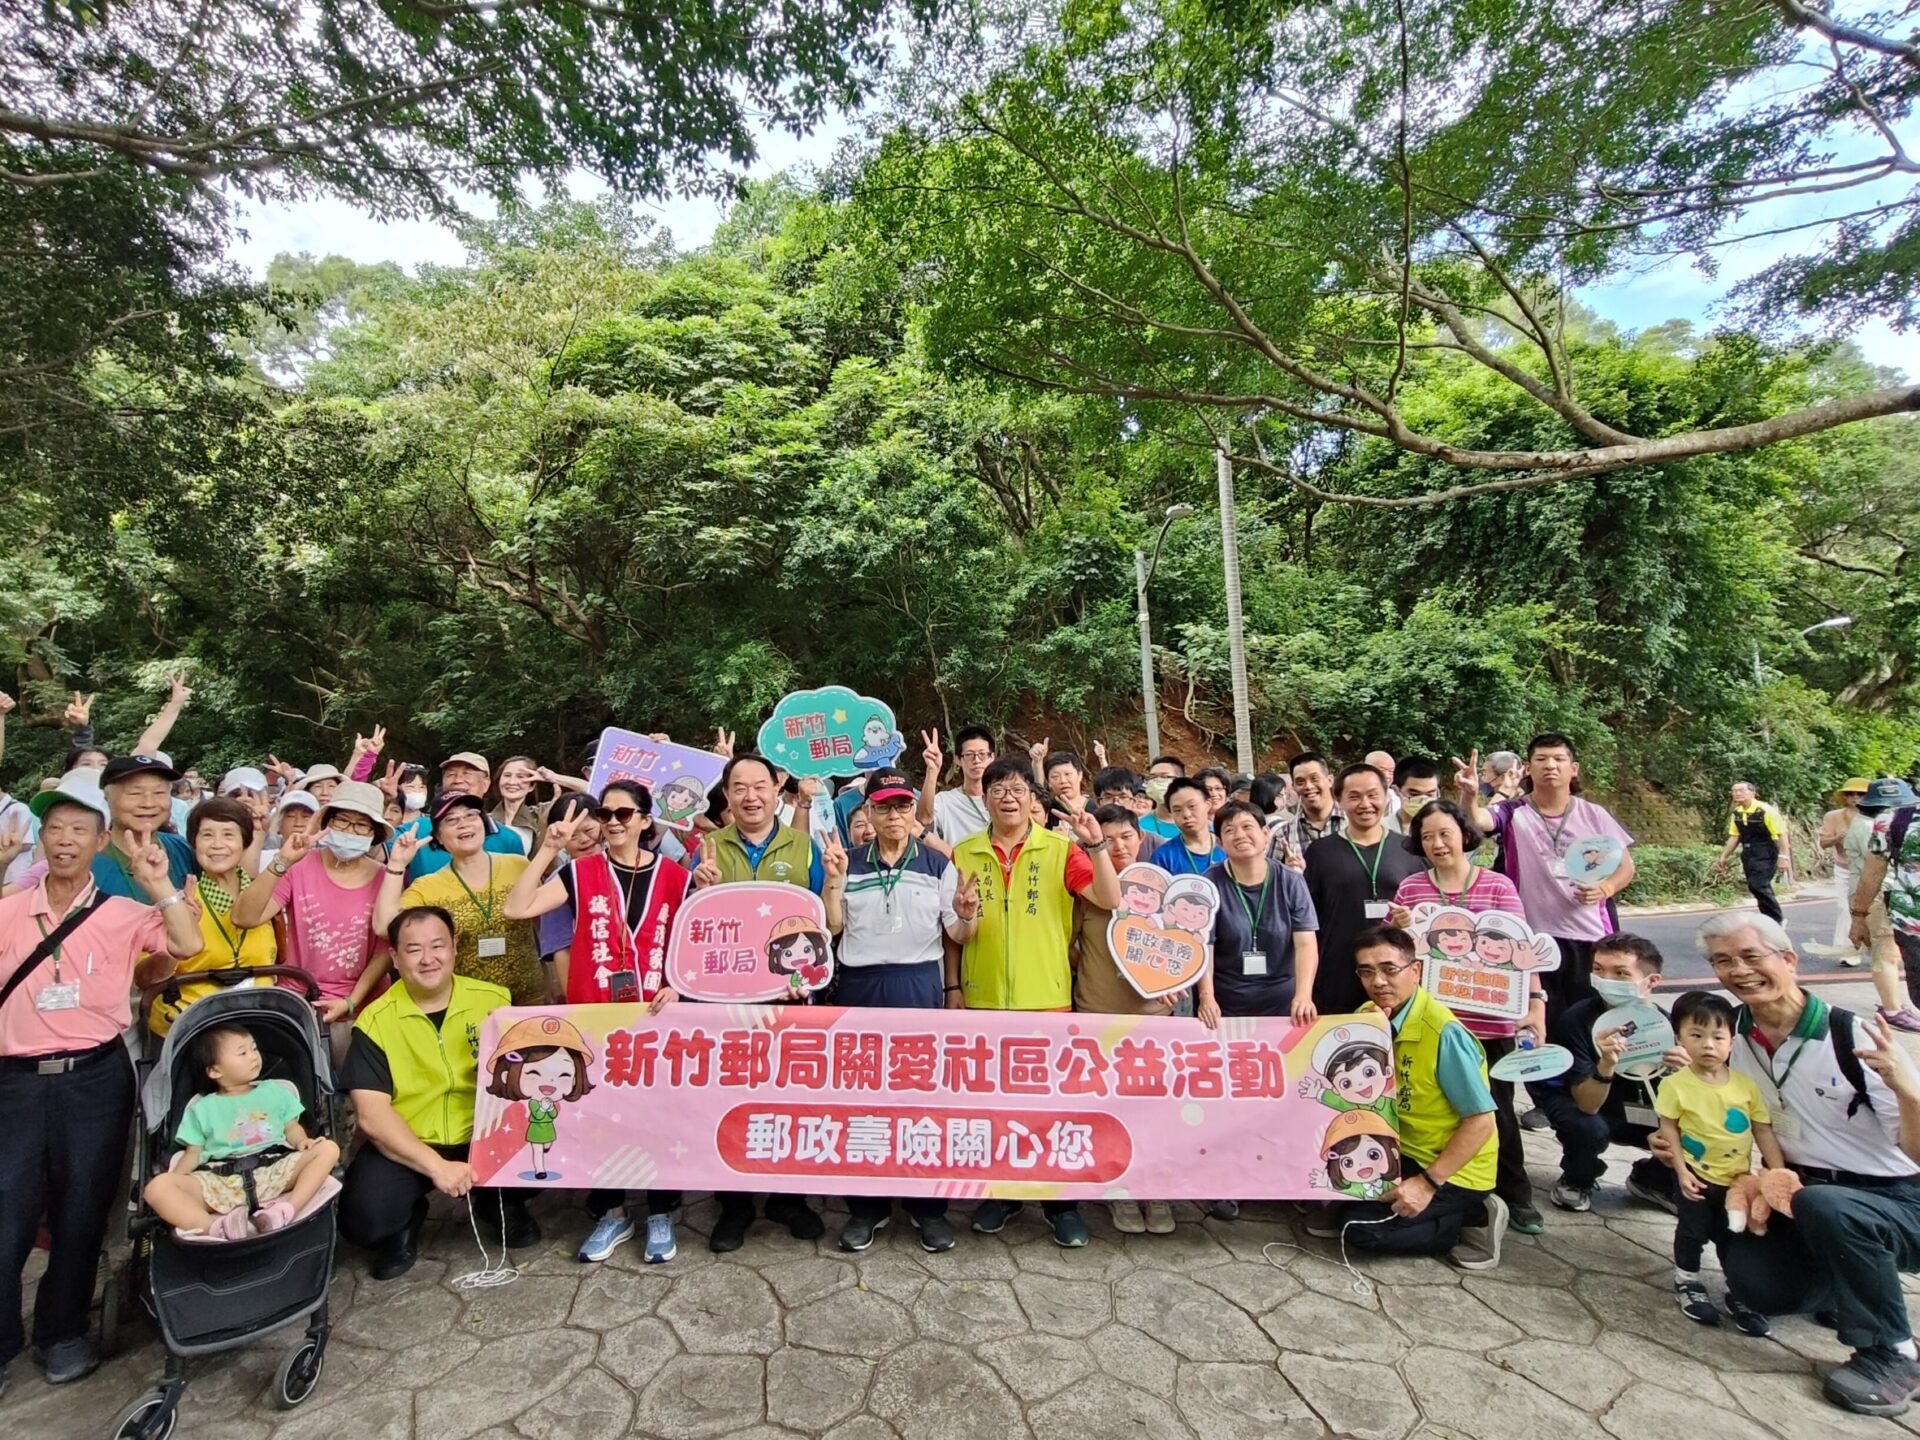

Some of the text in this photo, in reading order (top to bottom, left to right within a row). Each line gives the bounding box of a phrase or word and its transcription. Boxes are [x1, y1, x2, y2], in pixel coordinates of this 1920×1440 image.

[784, 712, 826, 738] 新竹
[609, 743, 660, 771] 新竹
[808, 735, 853, 760] 郵局
[1026, 861, 1040, 916] 新竹郵局
[588, 894, 613, 988] 誠信社會
[689, 918, 742, 944] 新竹
[1125, 927, 1194, 960] 郵政壽險
[703, 949, 757, 974] 郵局
[1125, 945, 1183, 976] 關心您
[1439, 965, 1510, 989] 新竹郵局
[604, 1029, 1285, 1099] 新竹郵局關愛社區公益活動
[1398, 1054, 1414, 1112] 新竹郵局
[745, 1113, 1096, 1170] 郵政壽險關心您
